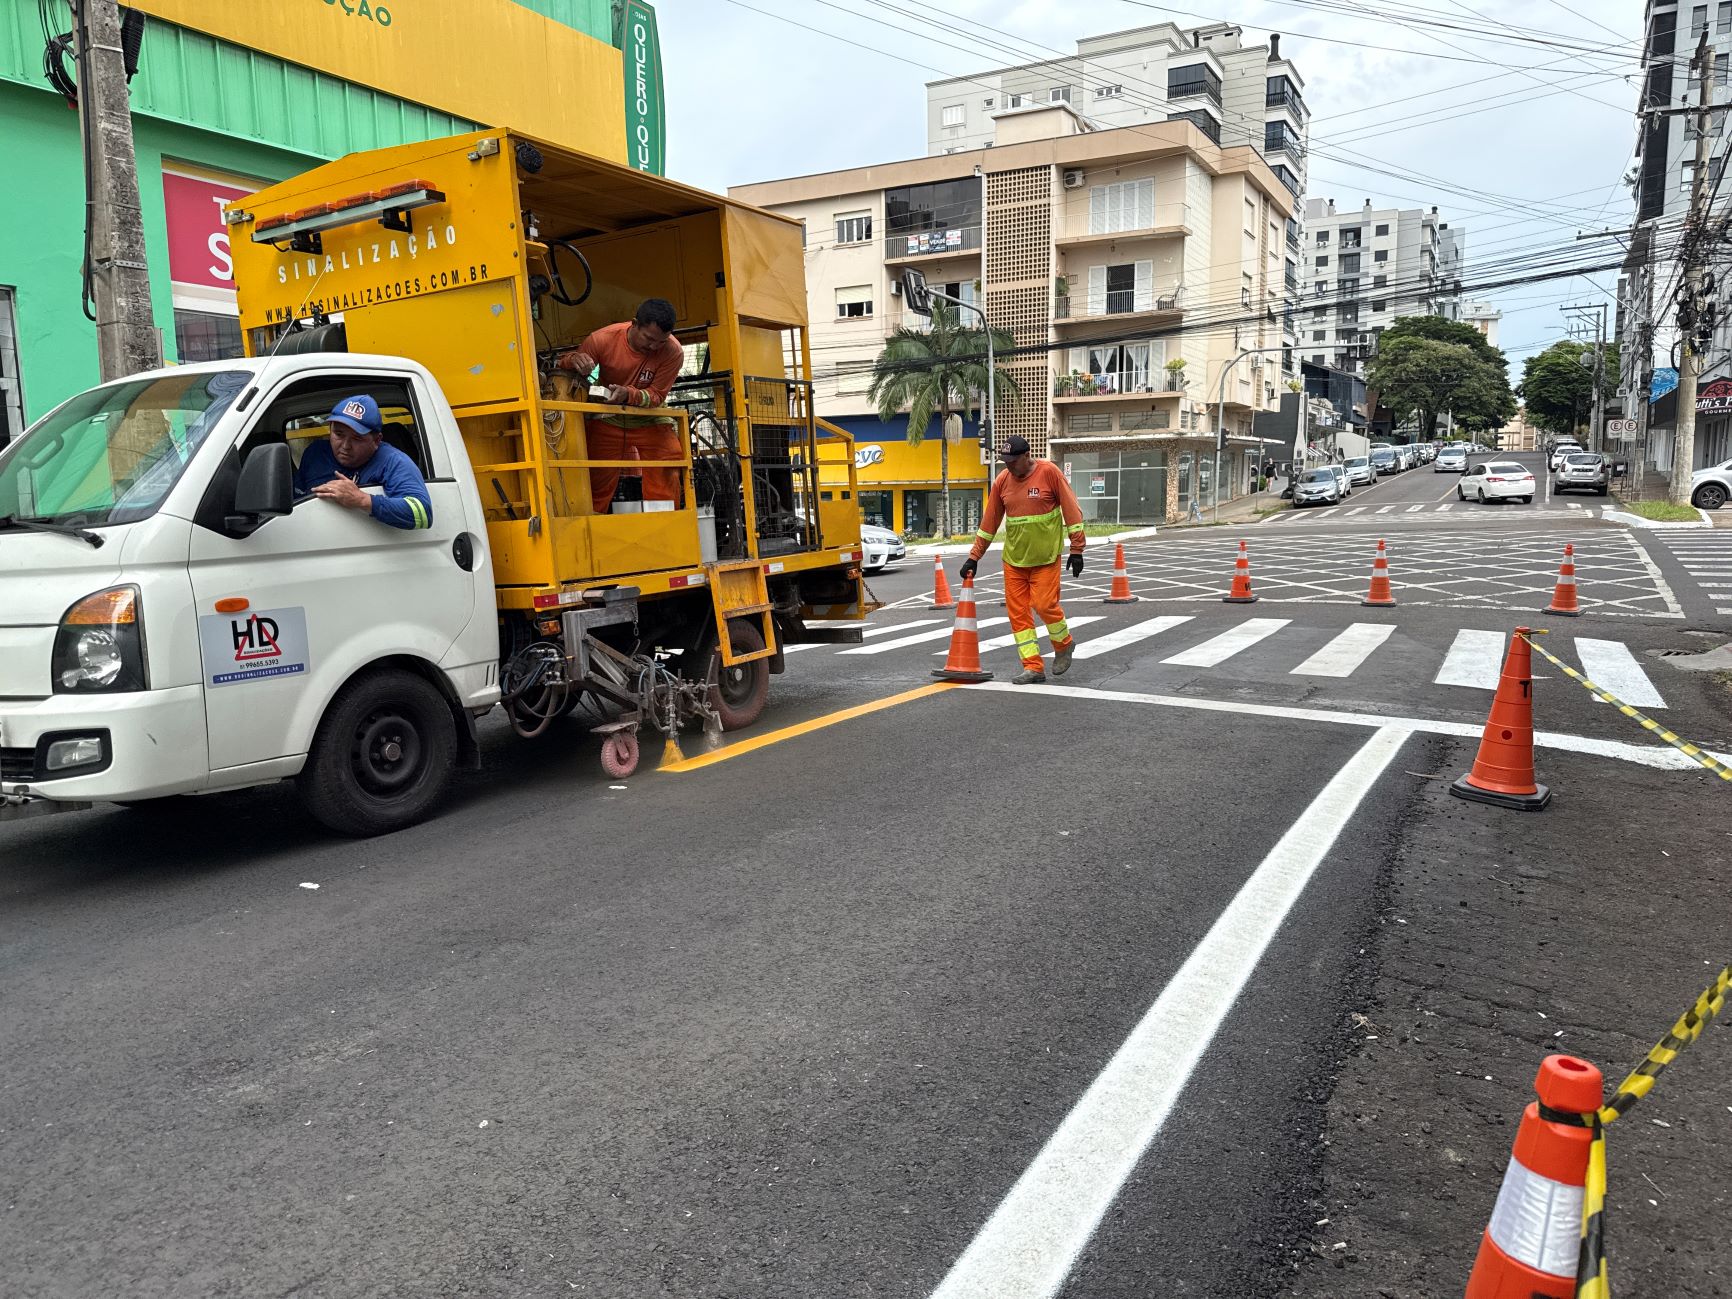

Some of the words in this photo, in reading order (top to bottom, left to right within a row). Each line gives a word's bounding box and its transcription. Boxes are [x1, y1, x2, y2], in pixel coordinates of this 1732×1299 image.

[634, 23, 648, 115] QUERO
[278, 225, 456, 283] SINALIZAÇÃO
[1695, 397, 1721, 408] utti's
[1028, 487, 1040, 495] HD
[231, 617, 279, 651] HD
